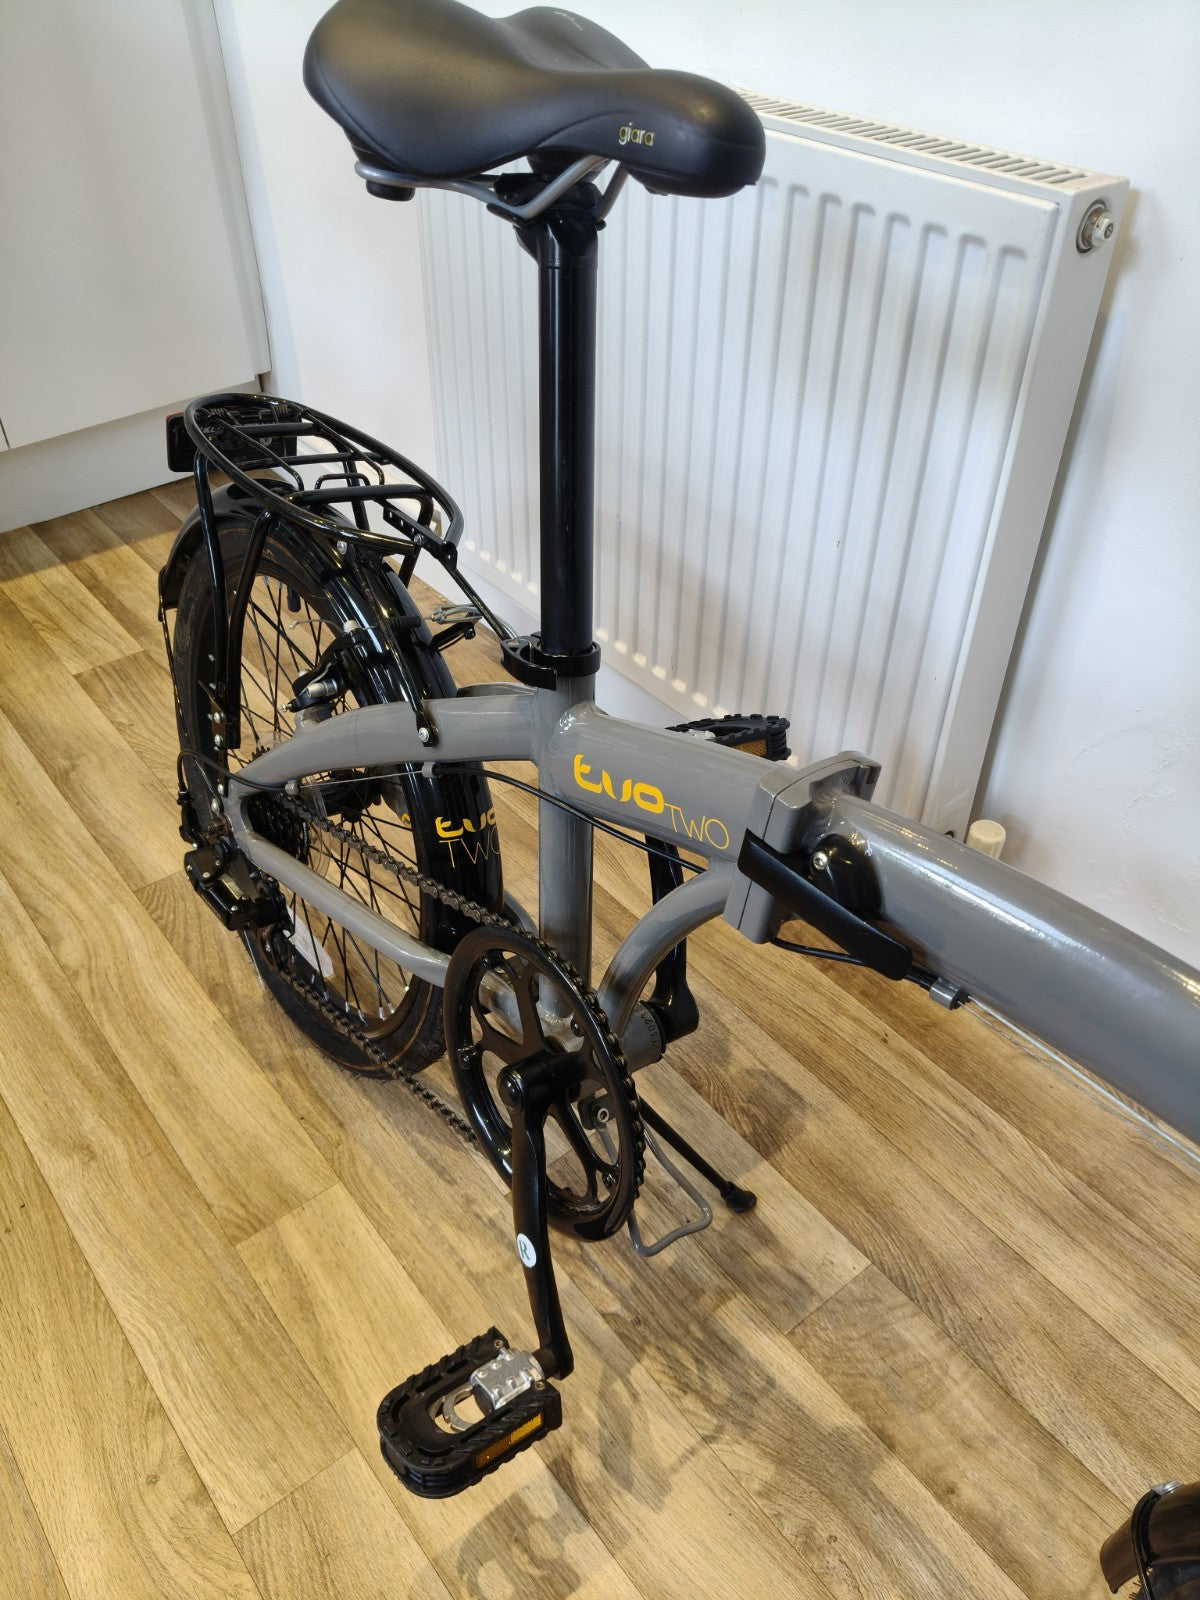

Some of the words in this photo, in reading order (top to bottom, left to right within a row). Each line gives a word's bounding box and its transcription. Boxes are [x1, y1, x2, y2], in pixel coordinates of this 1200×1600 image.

[618, 122, 654, 147] giara
[664, 802, 730, 850] TWO
[438, 825, 501, 869] TWO
[519, 1239, 531, 1261] R
